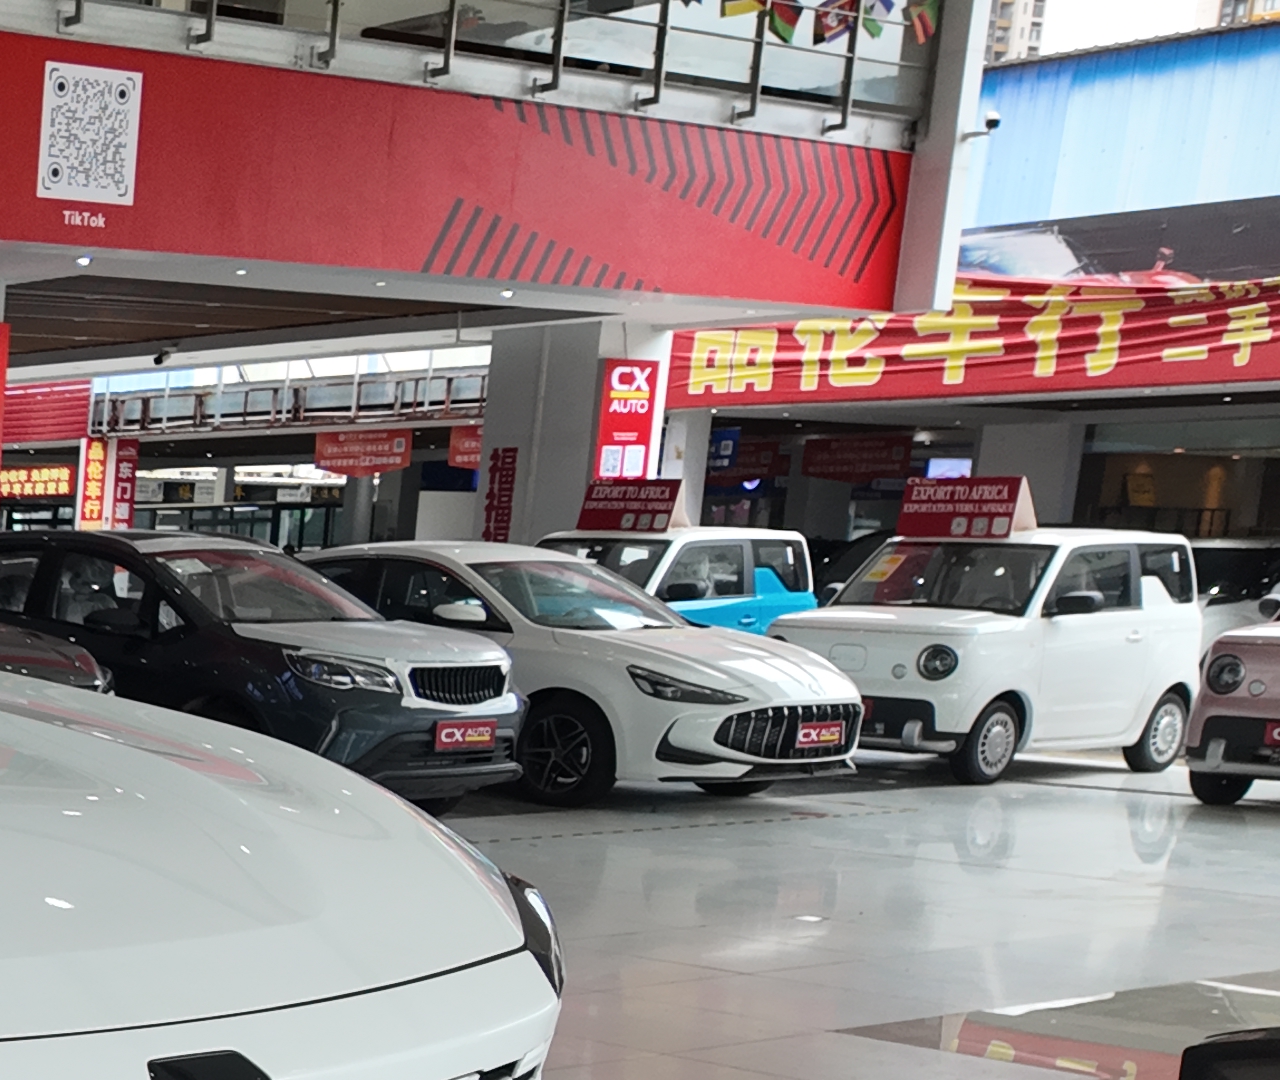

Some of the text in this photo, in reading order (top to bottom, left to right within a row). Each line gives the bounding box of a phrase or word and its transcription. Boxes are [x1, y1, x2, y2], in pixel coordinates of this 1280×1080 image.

[63, 210, 105, 228] TikTok
[611, 366, 652, 391] CX
[609, 399, 649, 414] AUTO
[592, 486, 628, 499] EXPORT
[640, 486, 671, 499] AFRICA
[911, 485, 1009, 500] EXPORT TO AFRICA
[441, 727, 491, 742] CX AUTO
[798, 728, 820, 742] CX
